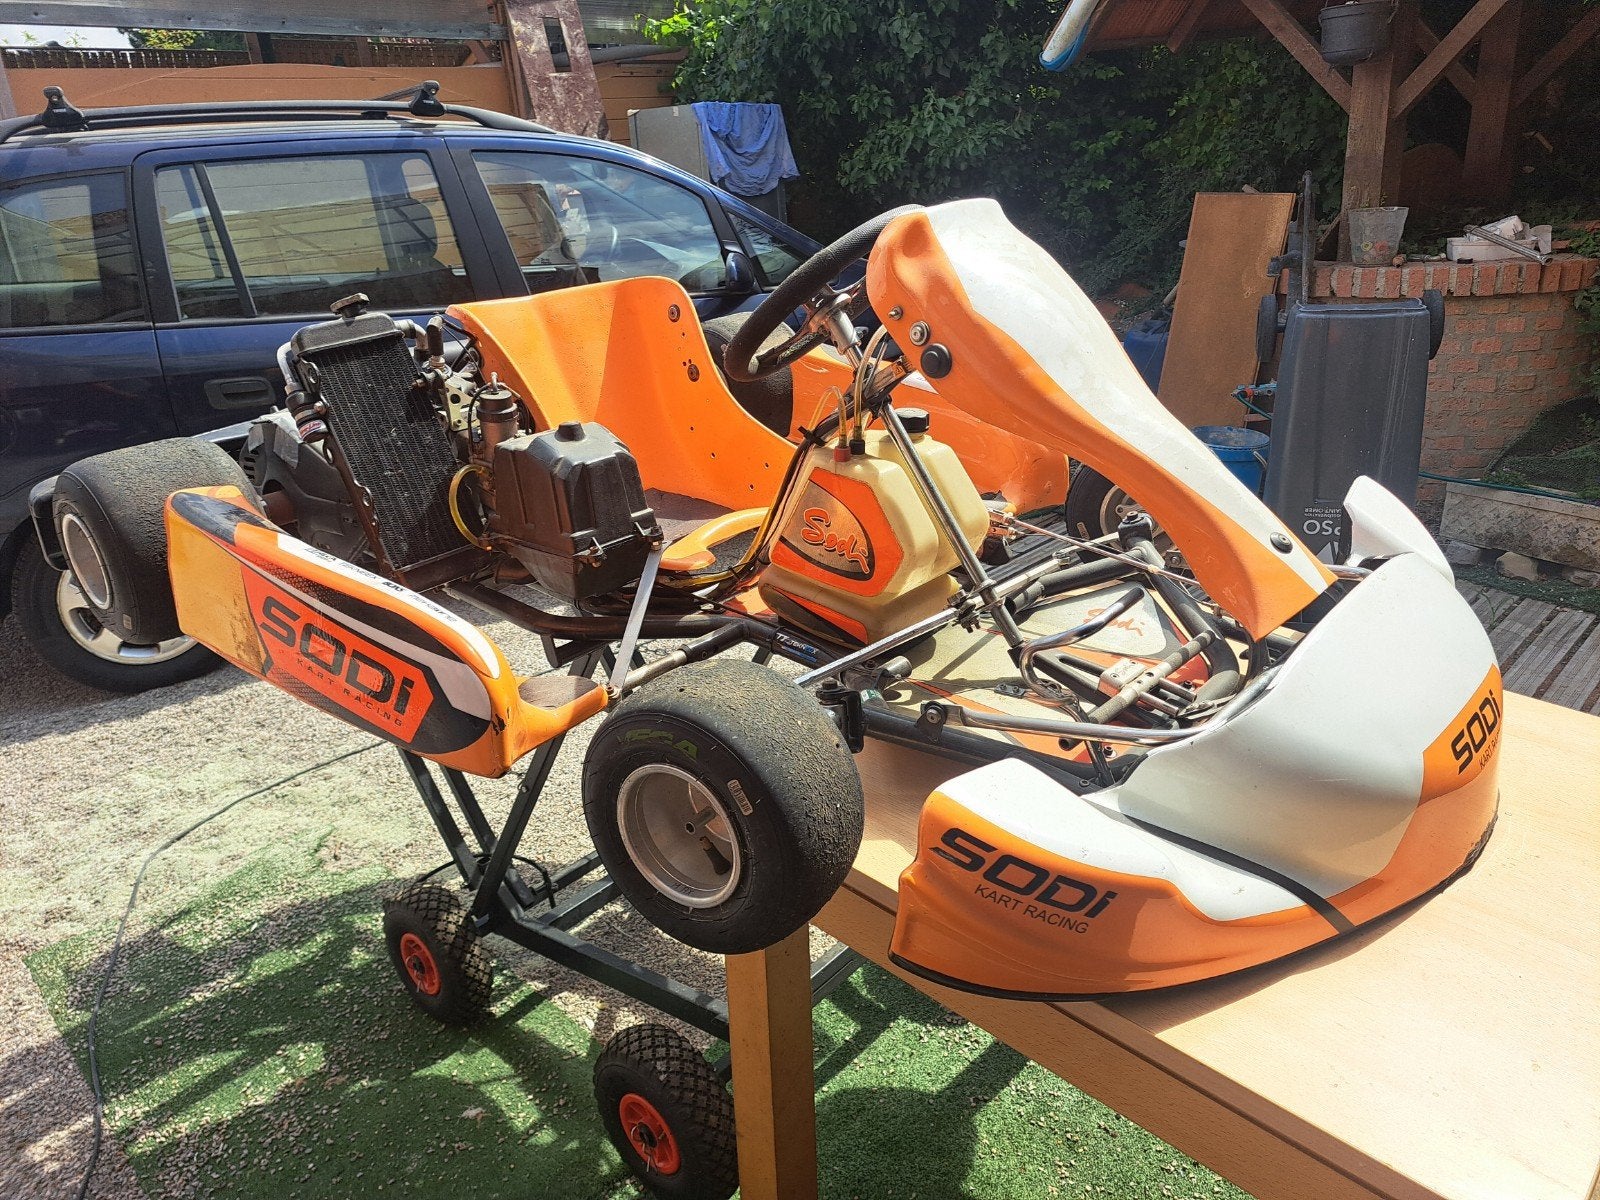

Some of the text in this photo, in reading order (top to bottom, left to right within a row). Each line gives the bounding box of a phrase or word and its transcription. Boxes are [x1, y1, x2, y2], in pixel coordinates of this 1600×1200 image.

[297, 657, 403, 728] KART RACING
[974, 884, 1089, 934] KART RACING
